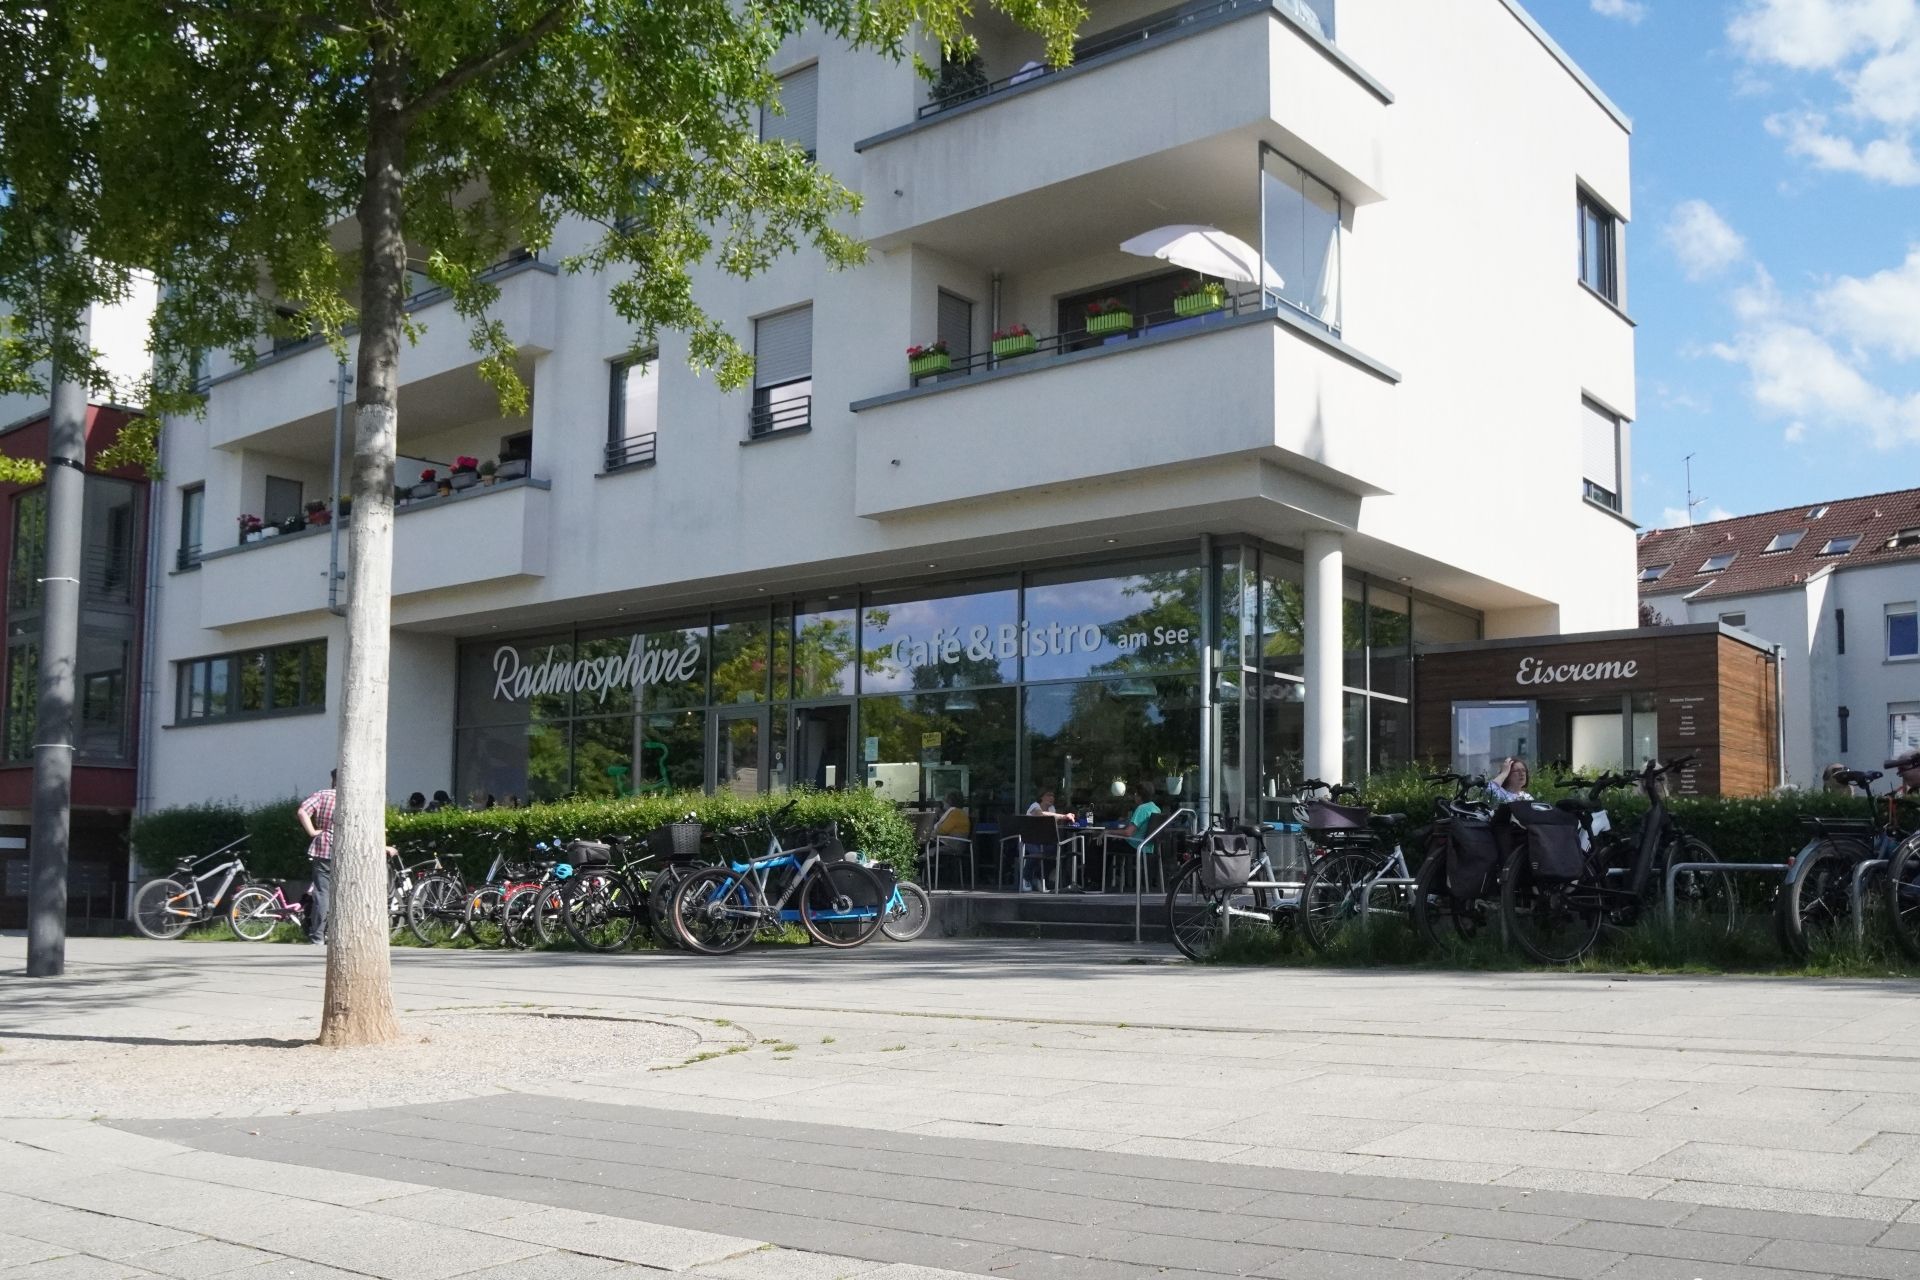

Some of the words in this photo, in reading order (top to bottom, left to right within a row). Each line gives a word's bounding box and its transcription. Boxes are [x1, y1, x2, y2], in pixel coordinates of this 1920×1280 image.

[492, 633, 701, 705] Radmosphäre
[890, 627, 961, 669] Café
[966, 624, 994, 663] &
[996, 620, 1103, 659] Bistro
[1117, 632, 1149, 650] am
[1153, 625, 1189, 646] See
[1515, 656, 1639, 686] Eiscreme
